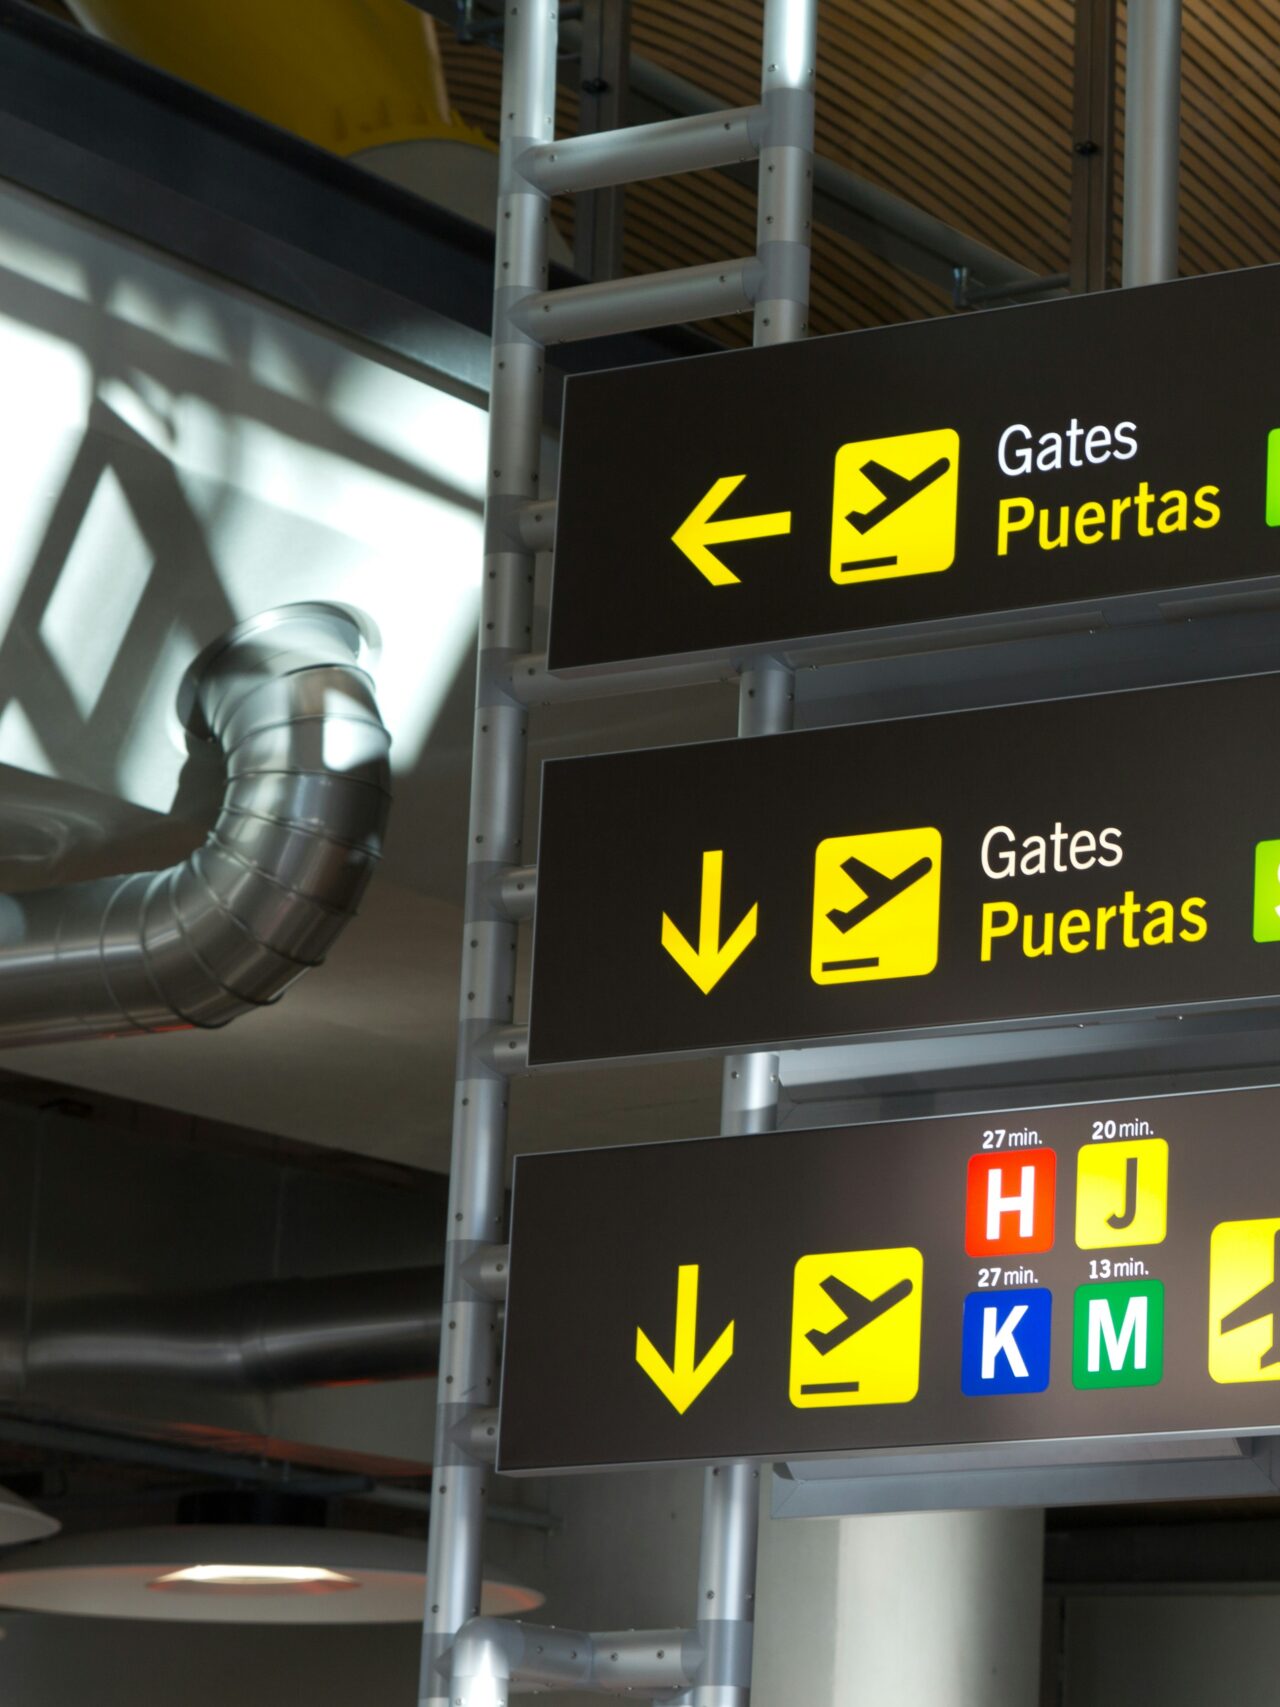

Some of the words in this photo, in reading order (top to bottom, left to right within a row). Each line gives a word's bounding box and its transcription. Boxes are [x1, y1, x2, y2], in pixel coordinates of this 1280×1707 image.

[998, 418, 1138, 477] Gates
[997, 482, 1221, 556] Puertas
[980, 822, 1124, 880] Gates
[980, 890, 1208, 962] Puertas
[986, 1165, 1036, 1240] H
[1106, 1157, 1139, 1229] J
[981, 1305, 1030, 1379] K
[1087, 1295, 1149, 1372] M
